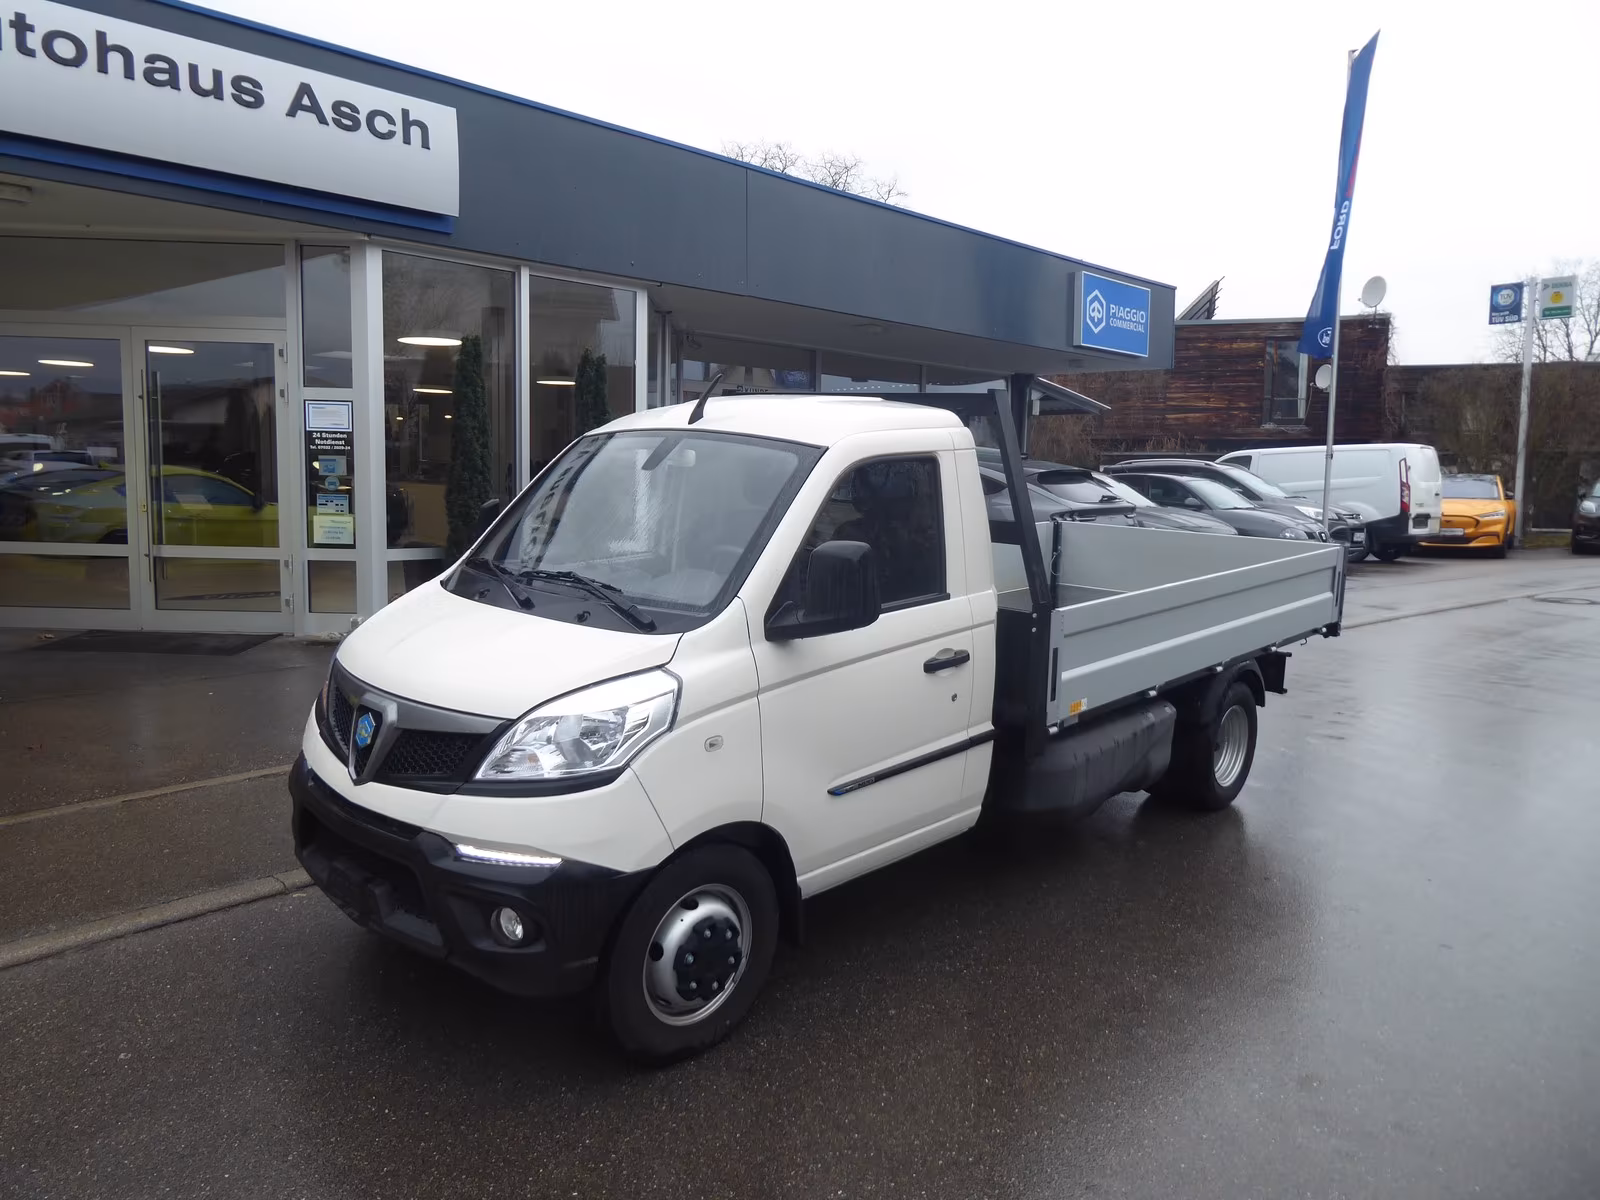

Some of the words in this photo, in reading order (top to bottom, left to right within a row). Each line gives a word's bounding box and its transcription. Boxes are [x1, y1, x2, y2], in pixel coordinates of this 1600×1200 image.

[0, 12, 265, 110] tohaus
[285, 82, 430, 150] Asch
[1109, 303, 1146, 323] PIAGGIO
[1109, 317, 1145, 333] COMMERCIAL
